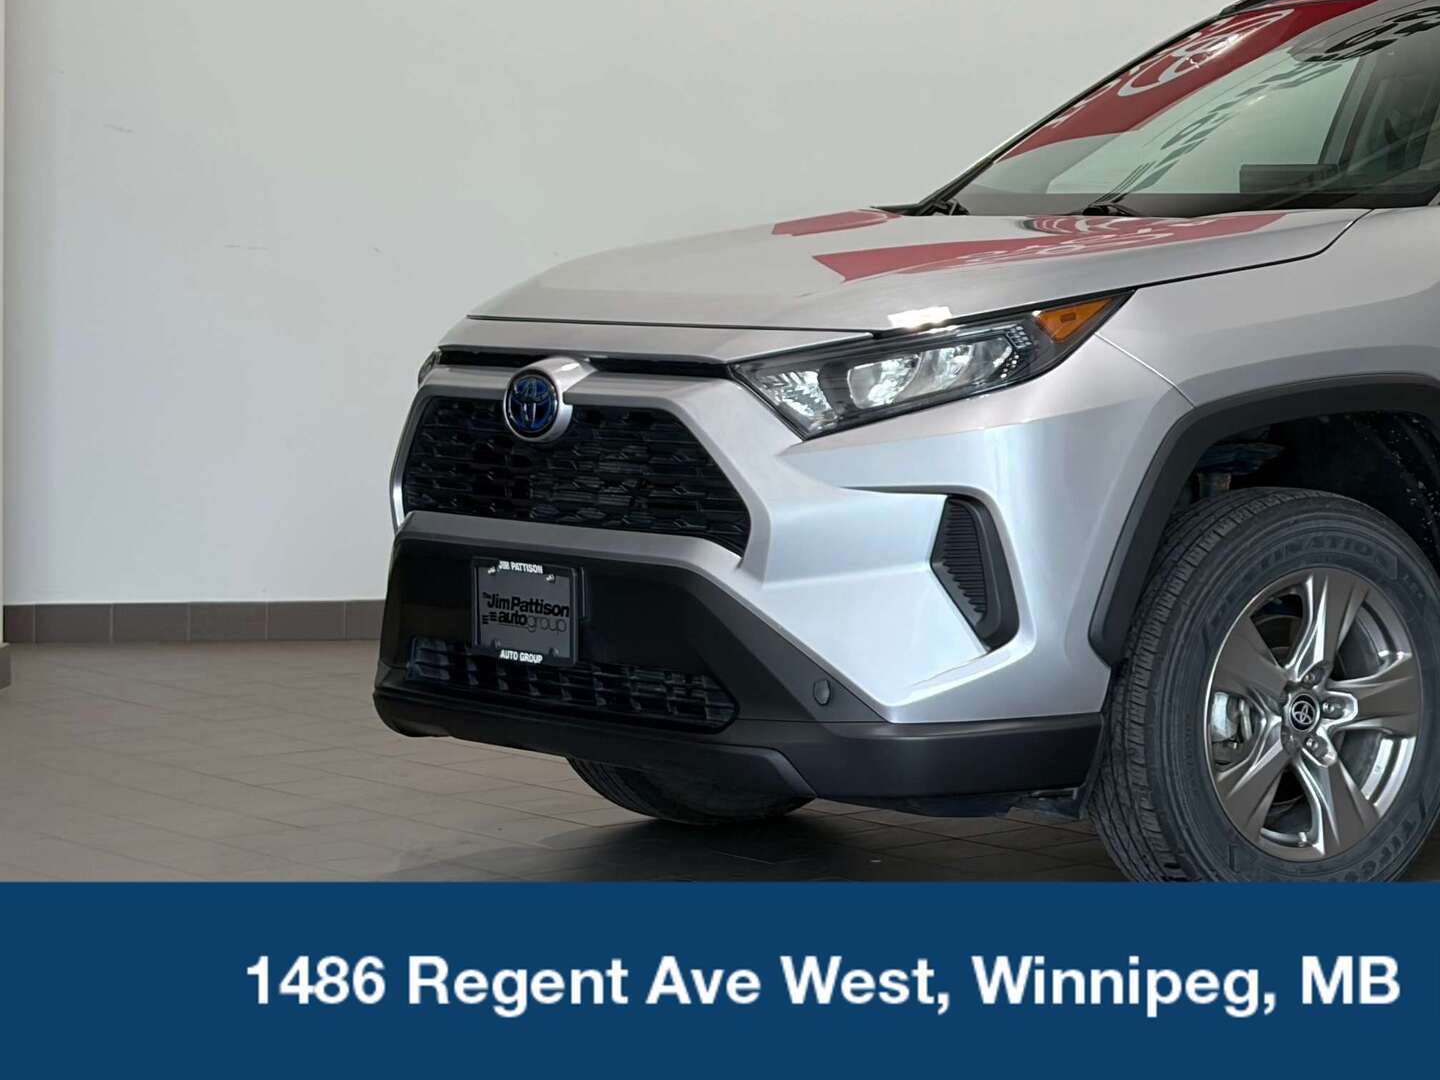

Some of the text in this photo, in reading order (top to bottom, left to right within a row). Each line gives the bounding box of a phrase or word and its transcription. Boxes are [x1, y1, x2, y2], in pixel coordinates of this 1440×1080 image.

[510, 561, 543, 574] PATTISON
[500, 649, 543, 664] AUTO GROUP
